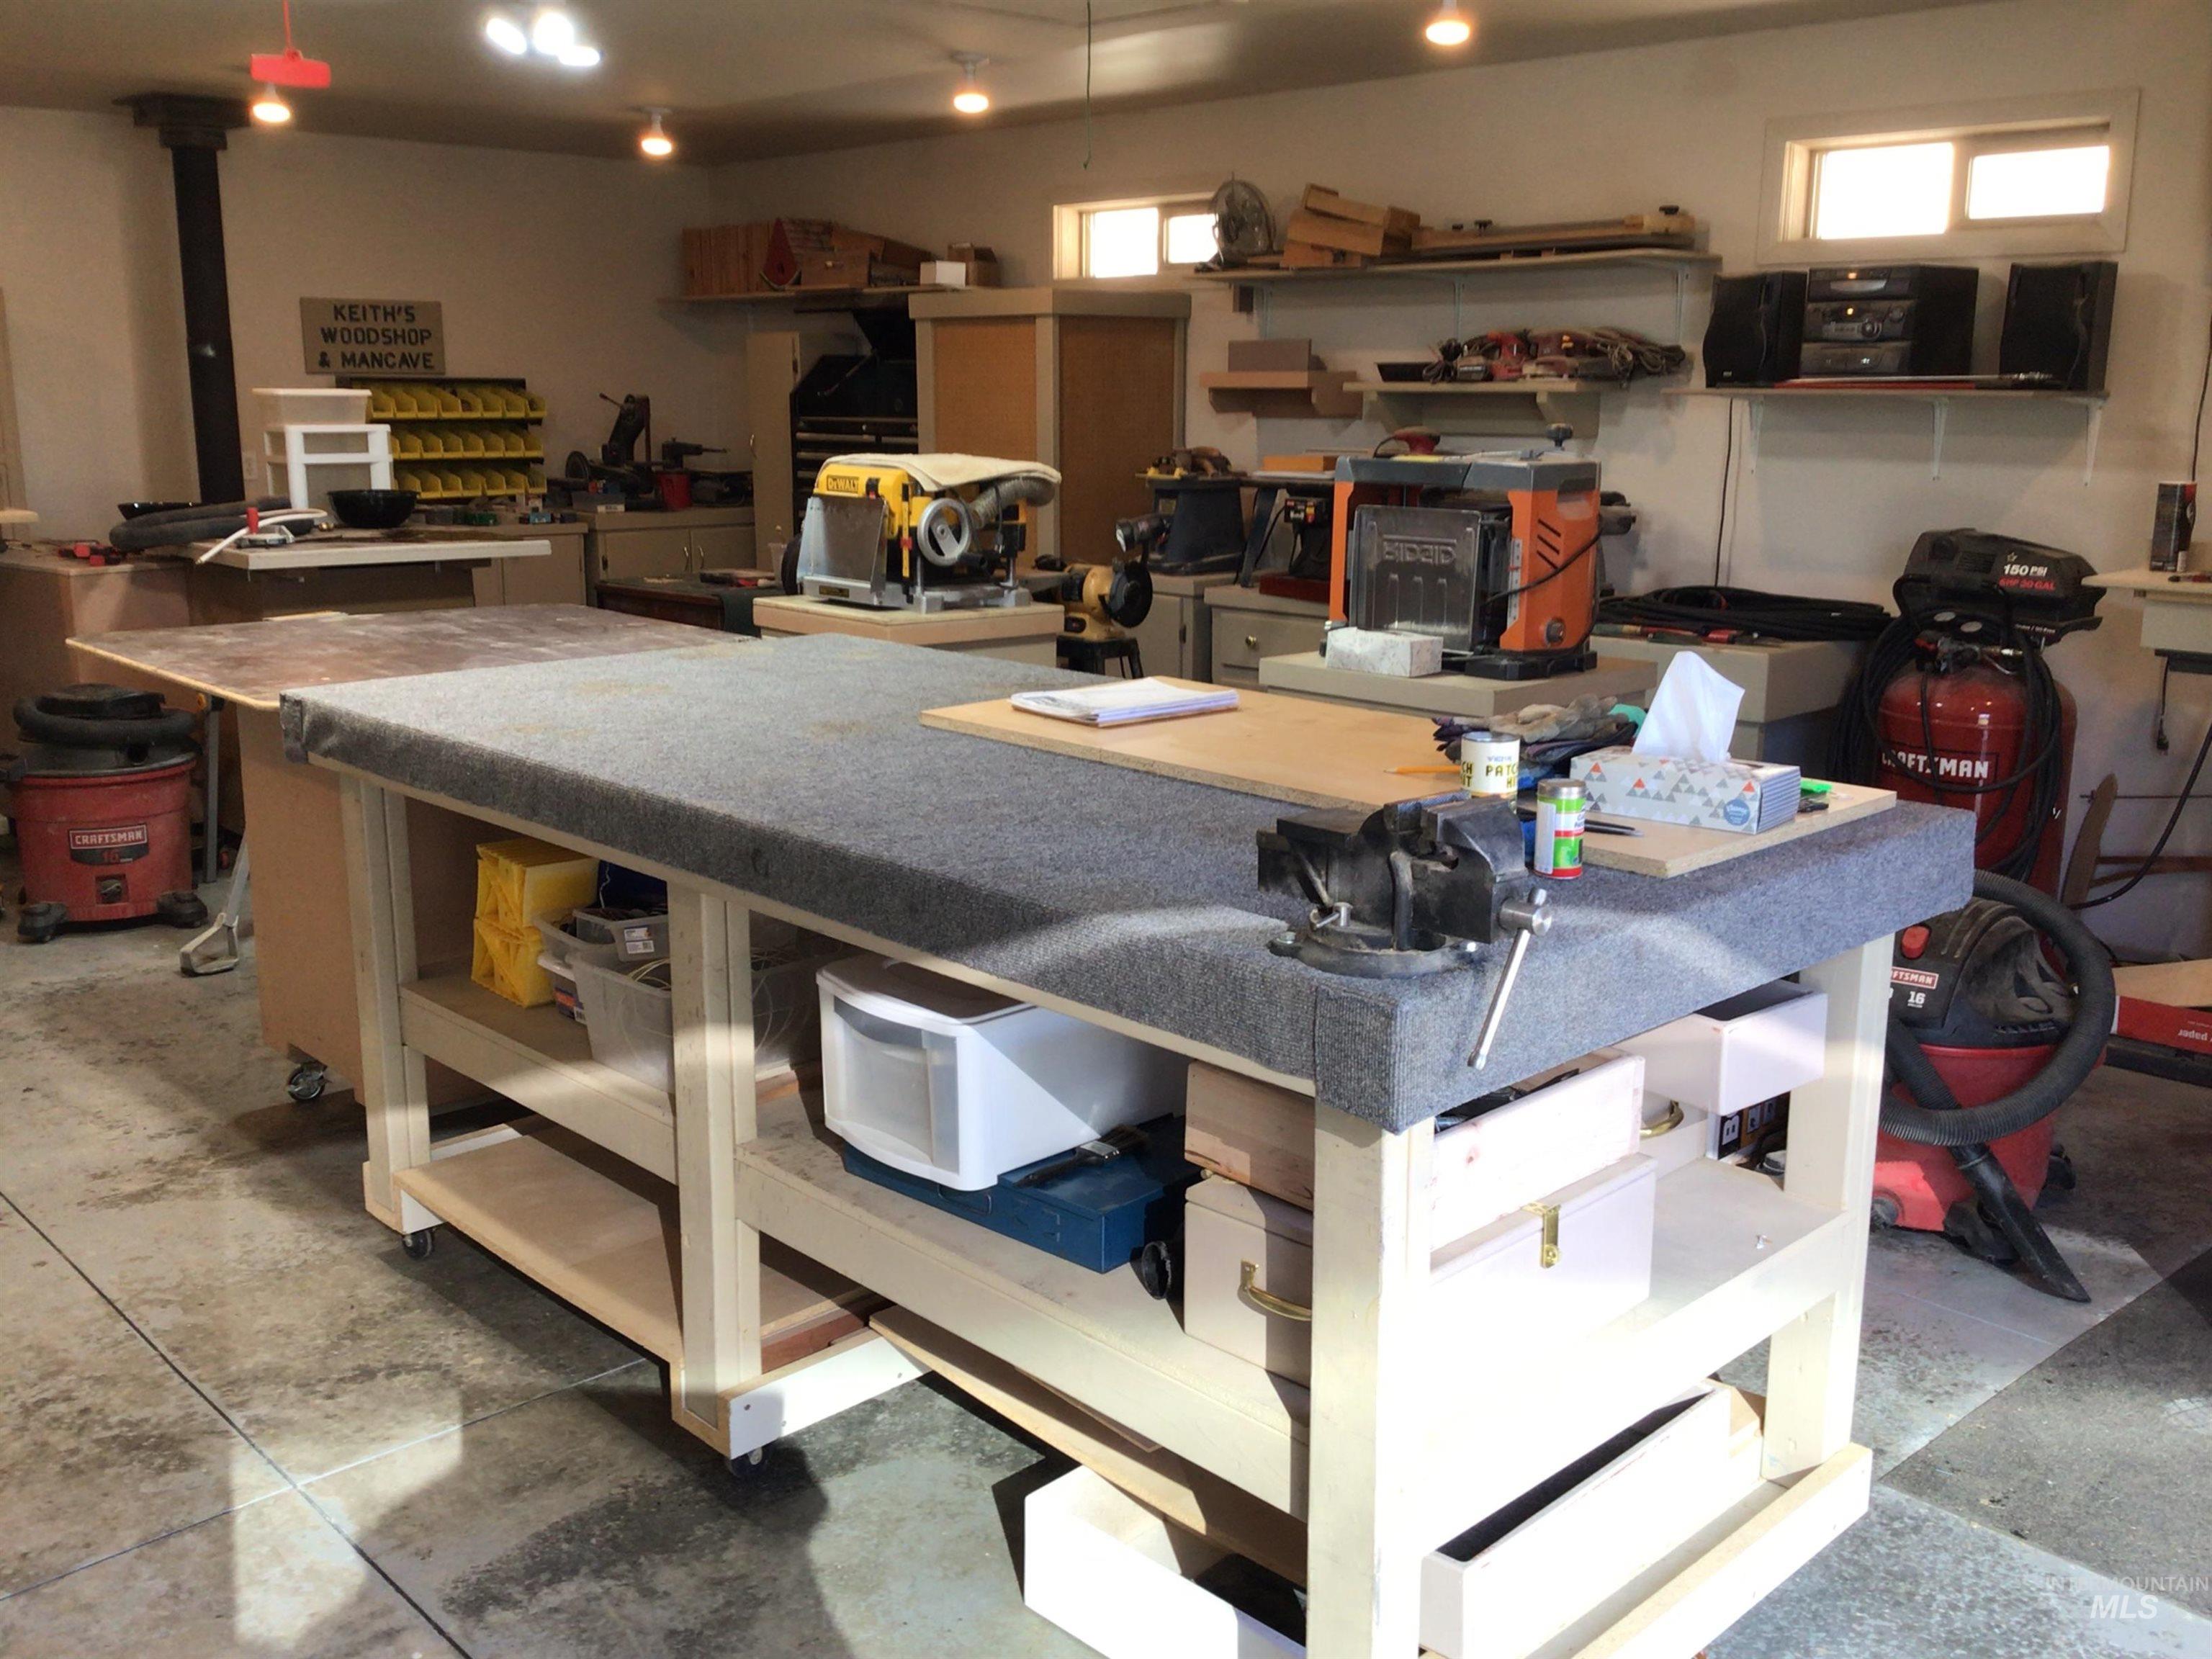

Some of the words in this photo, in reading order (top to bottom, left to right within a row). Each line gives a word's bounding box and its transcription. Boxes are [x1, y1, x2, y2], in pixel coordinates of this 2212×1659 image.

[333, 304, 415, 323] KEITH'S
[320, 326, 432, 346] WOODSHOP
[318, 351, 331, 369] &
[341, 351, 435, 369] MANCAVE
[2003, 563, 2029, 576] 150
[1881, 750, 1989, 778] AFTMAN
[75, 830, 143, 845] CRAFTSMAN
[1892, 971, 1933, 984] FTSMAN
[1907, 991, 1926, 1004] 16
